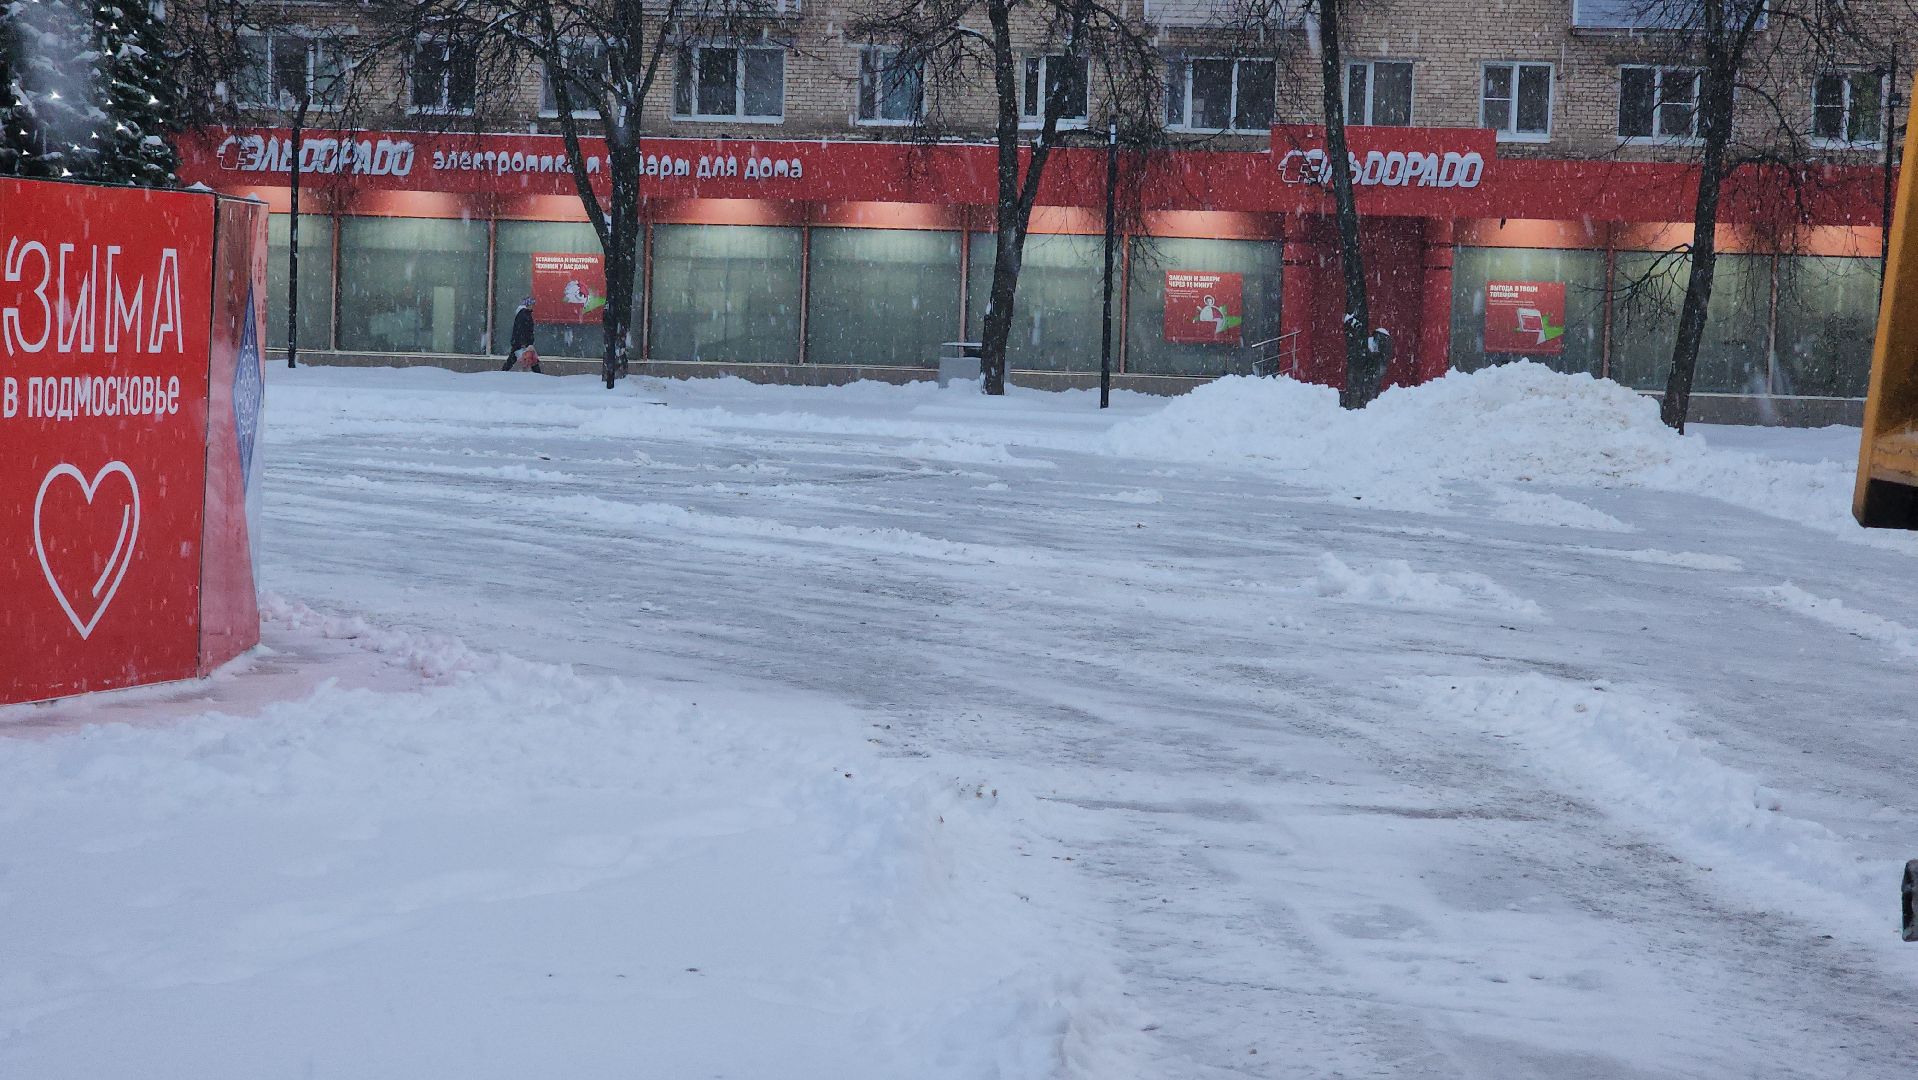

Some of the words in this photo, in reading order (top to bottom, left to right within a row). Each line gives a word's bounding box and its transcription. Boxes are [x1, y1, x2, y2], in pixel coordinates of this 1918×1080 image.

[586, 155, 600, 174] и
[696, 155, 738, 179] для
[744, 156, 804, 181] дома
[2, 235, 184, 357] ЗИМА
